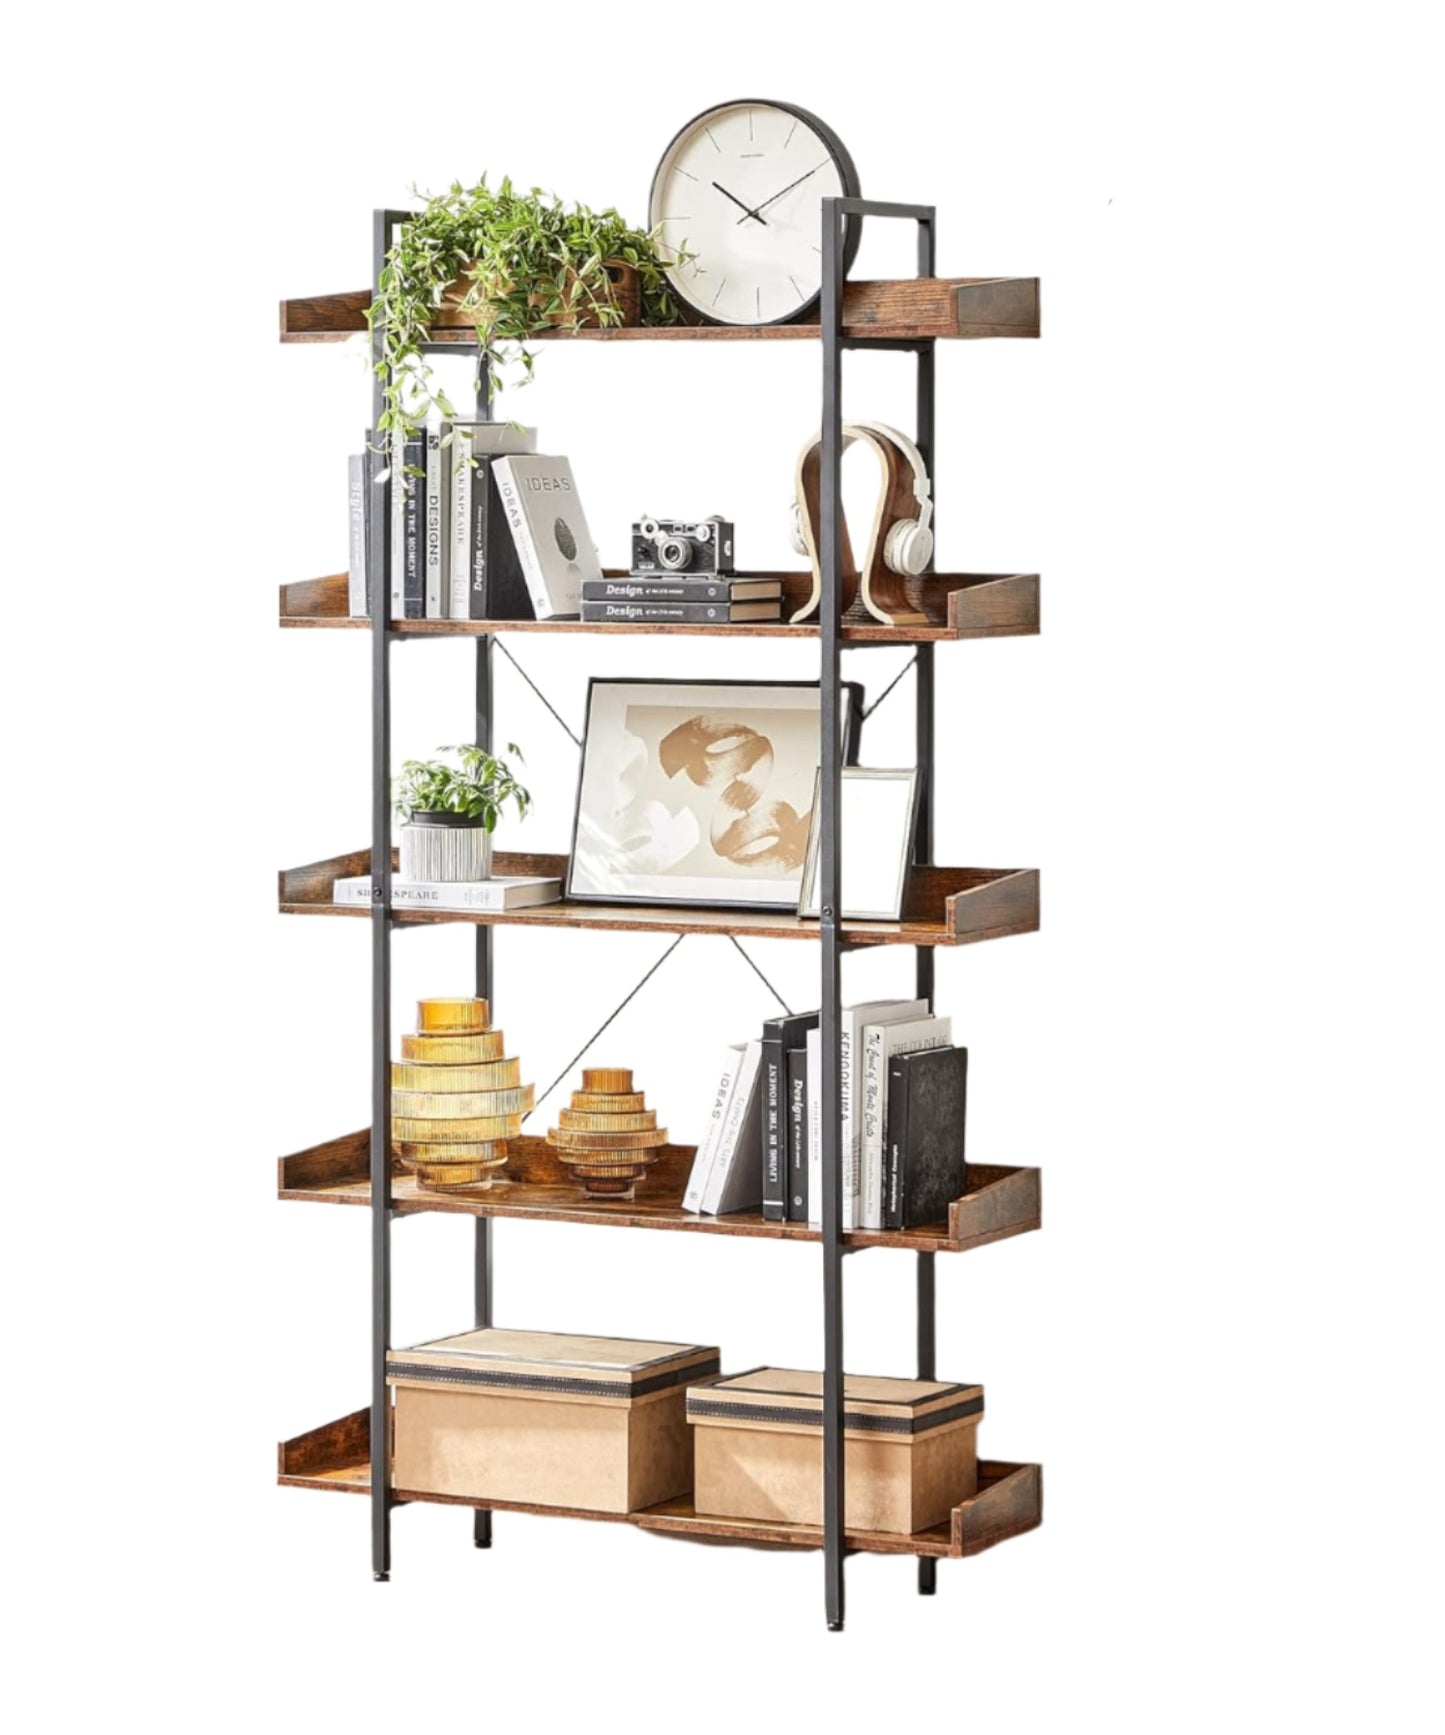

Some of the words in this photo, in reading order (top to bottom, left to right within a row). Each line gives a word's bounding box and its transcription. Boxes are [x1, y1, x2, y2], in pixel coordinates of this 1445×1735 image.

[526, 477, 572, 492] IDEAS
[408, 500, 416, 510] IN
[502, 482, 522, 529] IDEAS
[408, 514, 416, 533] THE
[429, 495, 439, 566] DESIGNS
[408, 537, 416, 578] MOMENT
[473, 549, 485, 592] Design
[606, 584, 643, 597] Design
[606, 605, 643, 618] Design
[357, 889, 439, 900] SHSPEARE
[712, 1072, 731, 1120] IDEAS
[769, 1063, 778, 1106] MOMENT
[792, 1078, 804, 1122] Design
[769, 1110, 778, 1131] THE
[769, 1134, 778, 1145] IN
[769, 1149, 778, 1182] LIVING
